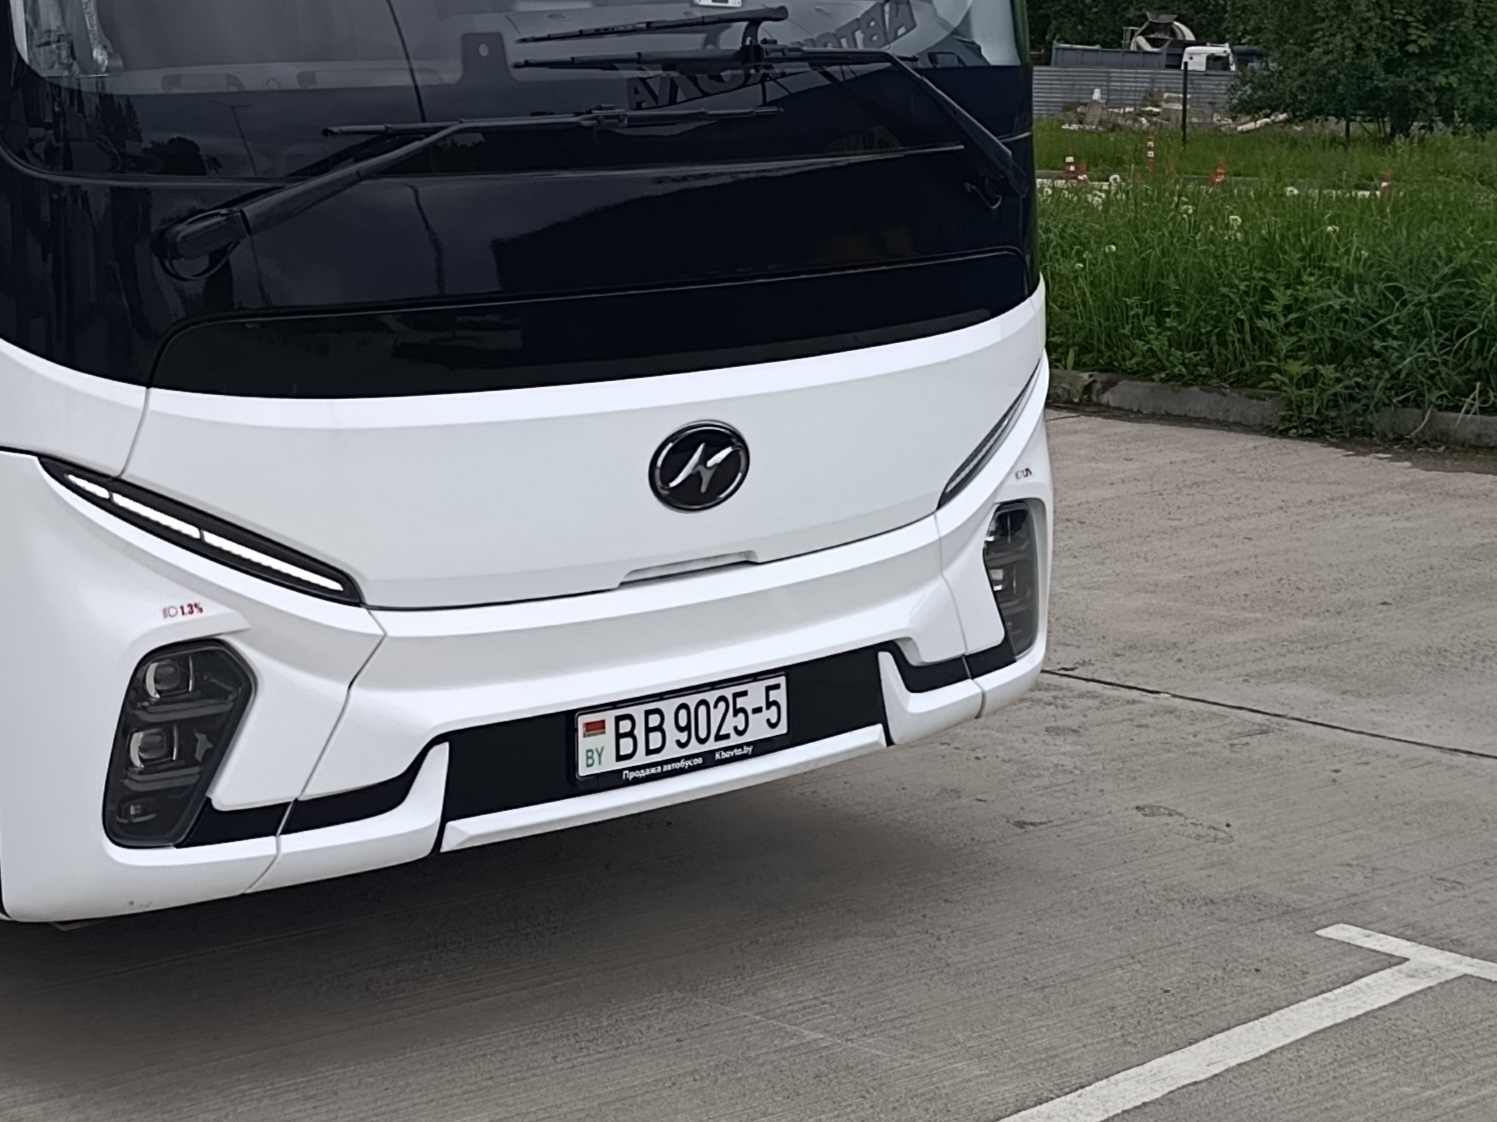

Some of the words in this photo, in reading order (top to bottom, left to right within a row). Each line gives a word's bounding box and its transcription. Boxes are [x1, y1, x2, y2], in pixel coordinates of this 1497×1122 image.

[585, 746, 605, 768] BY
[622, 762, 662, 781] Продажа
[662, 757, 703, 773] автобусов
